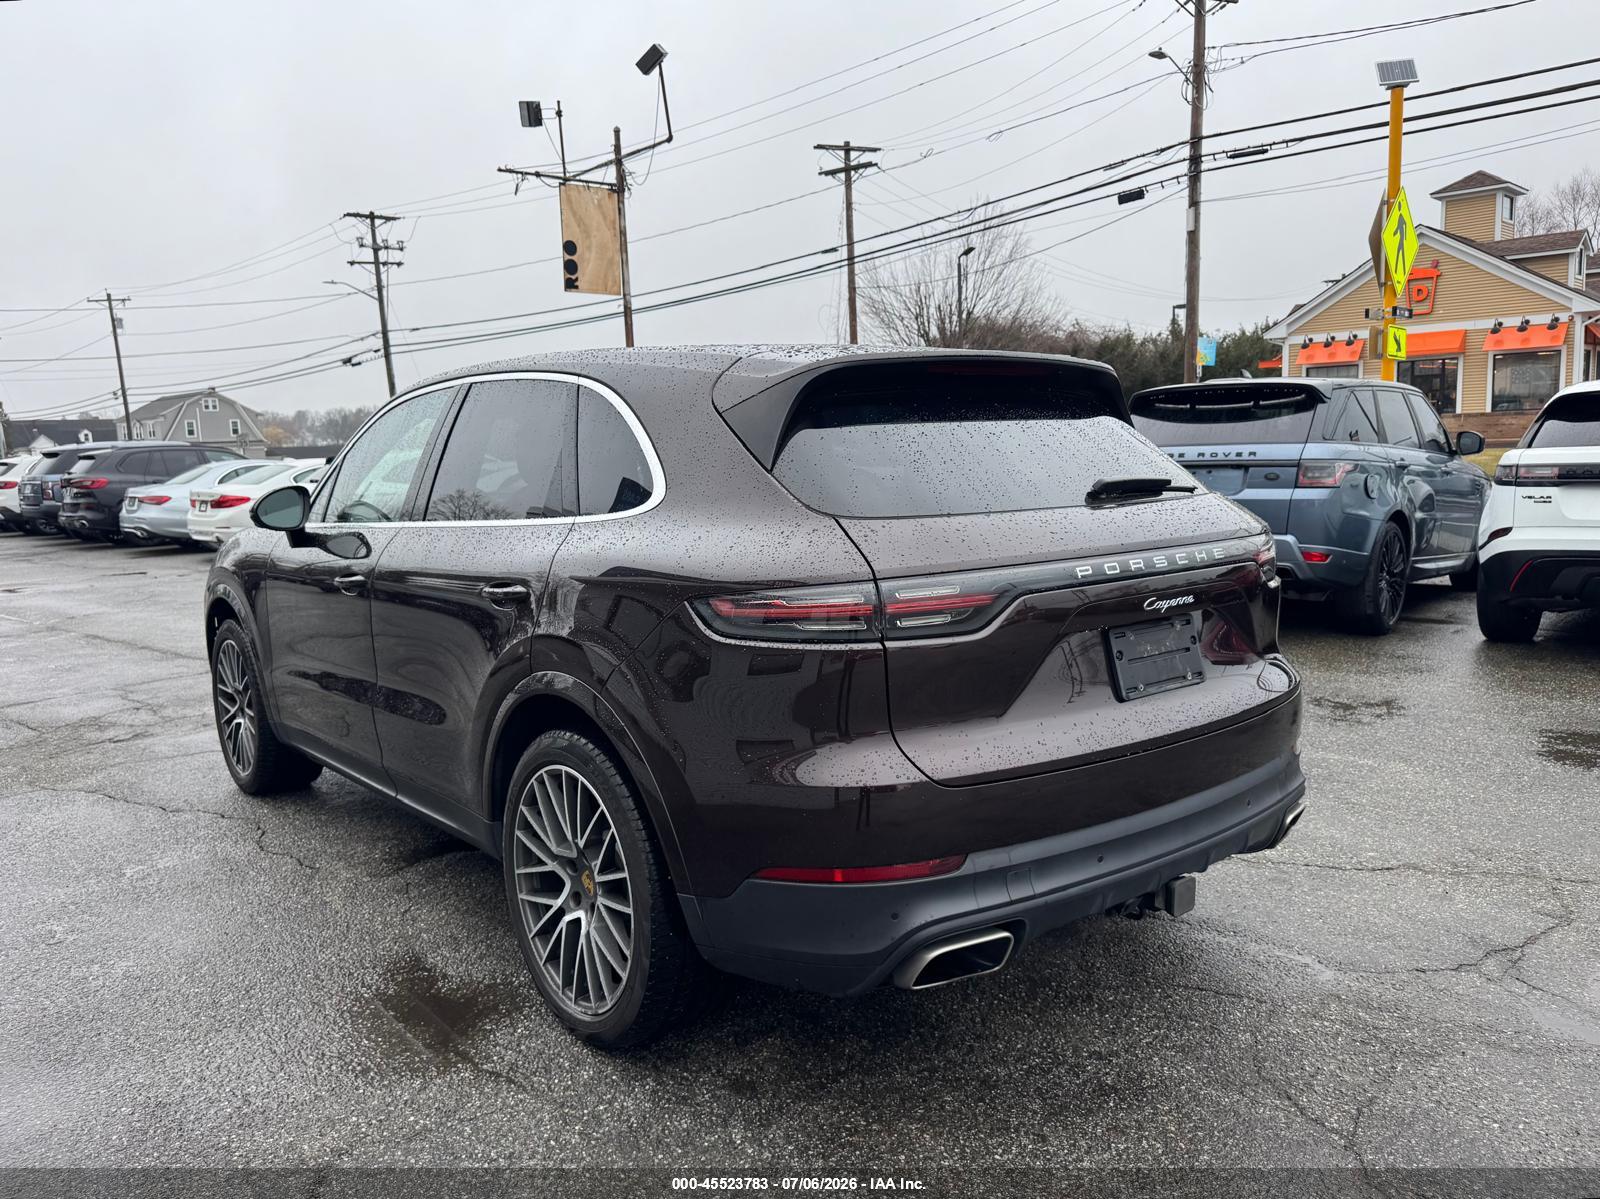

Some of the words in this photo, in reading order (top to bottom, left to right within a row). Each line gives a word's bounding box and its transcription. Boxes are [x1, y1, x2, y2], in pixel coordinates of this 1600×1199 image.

[1412, 285, 1429, 302] D
[1075, 548, 1226, 579] PORSCHE
[1143, 594, 1195, 613] Cayenne
